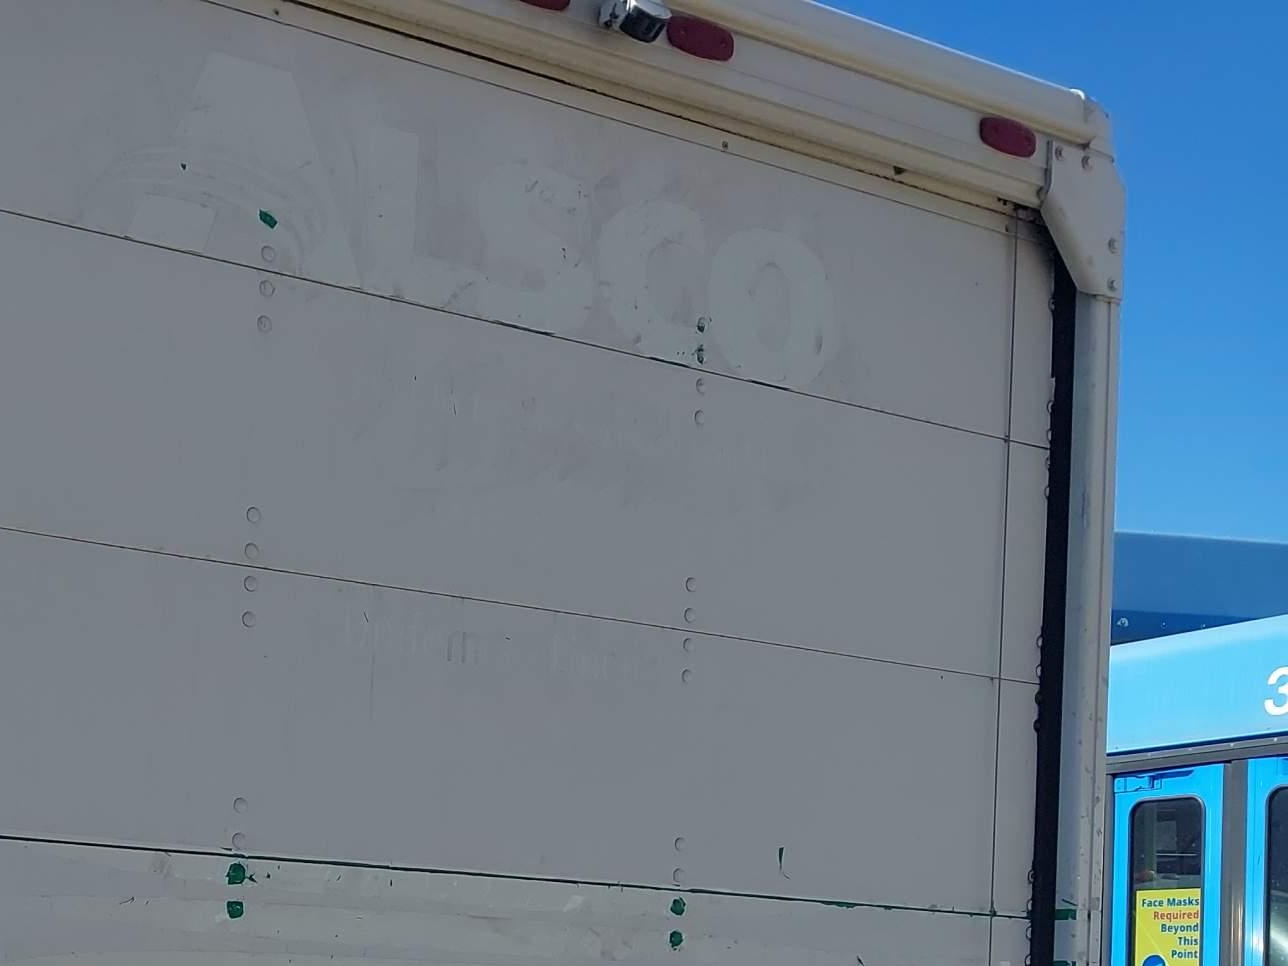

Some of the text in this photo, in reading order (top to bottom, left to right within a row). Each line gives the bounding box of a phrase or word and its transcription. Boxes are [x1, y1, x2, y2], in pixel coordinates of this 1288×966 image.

[1141, 897, 1200, 908] Face Masks
[1153, 910, 1200, 922] Required
[1160, 923, 1200, 935] Beyond
[1177, 936, 1199, 946] This
[1171, 949, 1199, 959] Point
